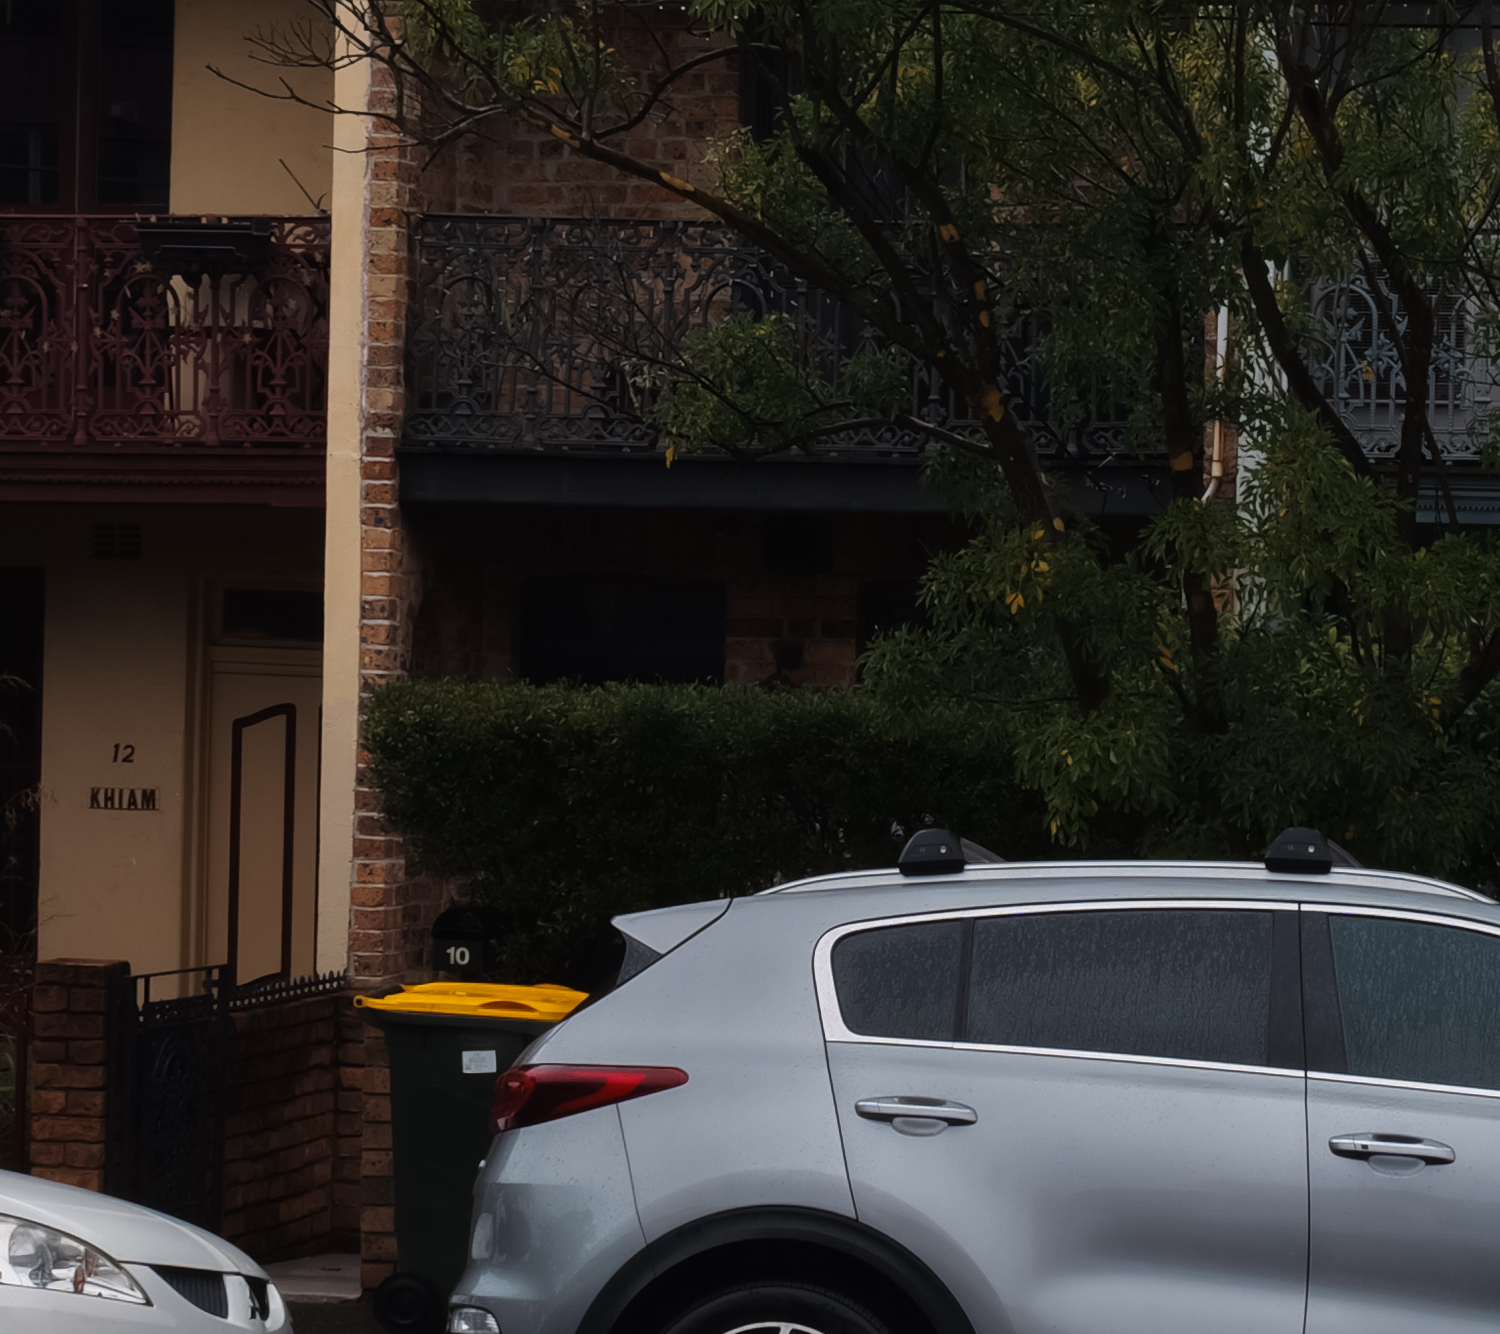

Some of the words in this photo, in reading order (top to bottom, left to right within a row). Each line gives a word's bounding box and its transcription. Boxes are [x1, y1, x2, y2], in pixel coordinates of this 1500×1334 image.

[112, 742, 136, 764] 12
[89, 787, 157, 811] KHIAM
[446, 946, 470, 966] 10
